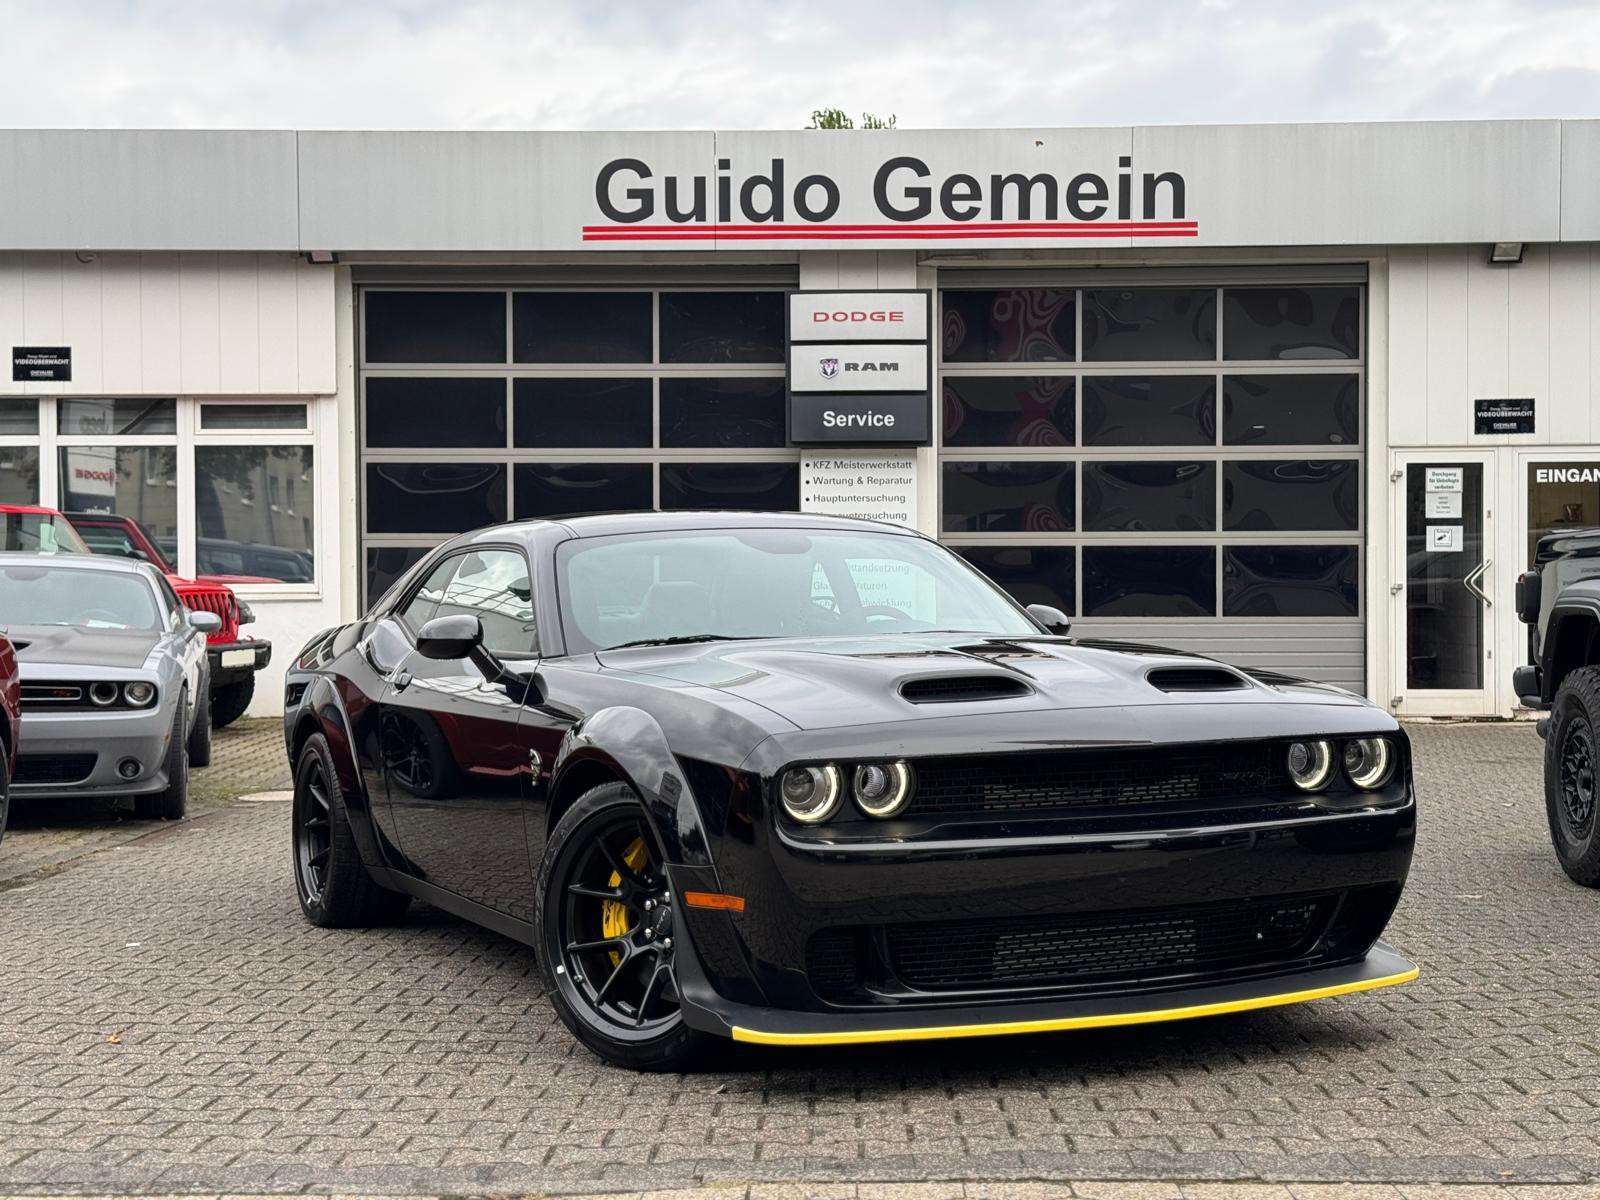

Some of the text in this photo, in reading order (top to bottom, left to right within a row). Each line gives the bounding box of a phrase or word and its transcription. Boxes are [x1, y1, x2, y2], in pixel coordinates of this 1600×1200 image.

[595, 156, 1186, 223] Guido Gemein
[813, 312, 904, 323] DODGE
[844, 362, 899, 372] RAM
[823, 411, 895, 427] Service
[813, 460, 912, 469] KFZ Meisterwerkstatt
[813, 476, 912, 486] Wartung & Reparatur
[813, 494, 906, 504] Hauptuntersuchung
